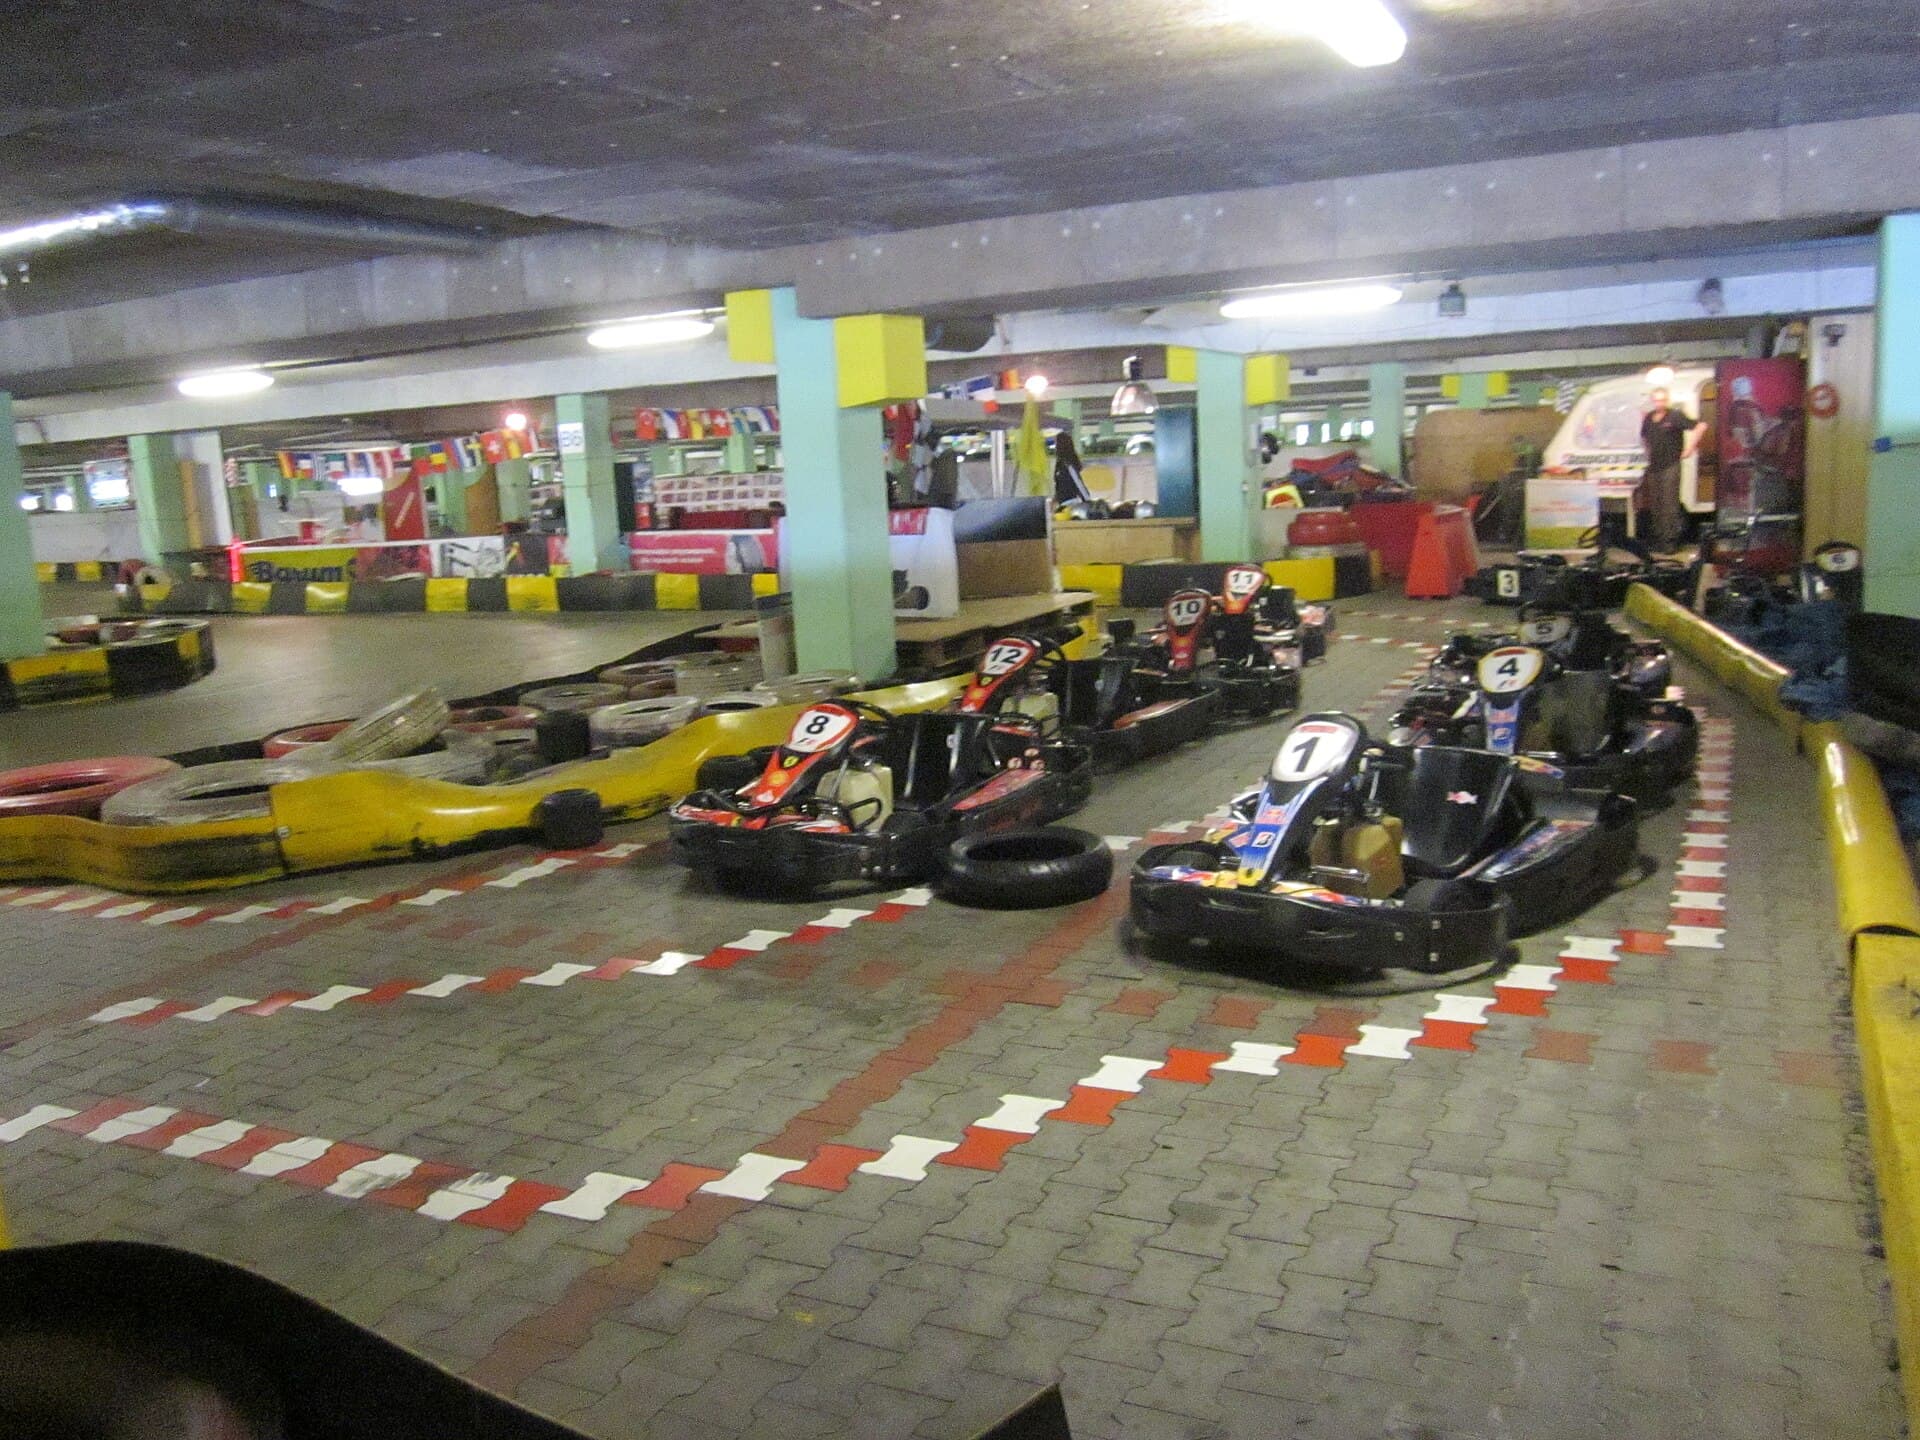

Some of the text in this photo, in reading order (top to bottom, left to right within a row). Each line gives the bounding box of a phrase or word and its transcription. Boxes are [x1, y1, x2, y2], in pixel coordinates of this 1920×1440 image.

[1232, 573, 1254, 584] 11
[1503, 573, 1514, 593] 3
[1173, 601, 1200, 616] 10
[991, 647, 1022, 664] 12
[1497, 657, 1519, 676] 4
[806, 715, 830, 735] 8
[1293, 736, 1321, 773] 1
